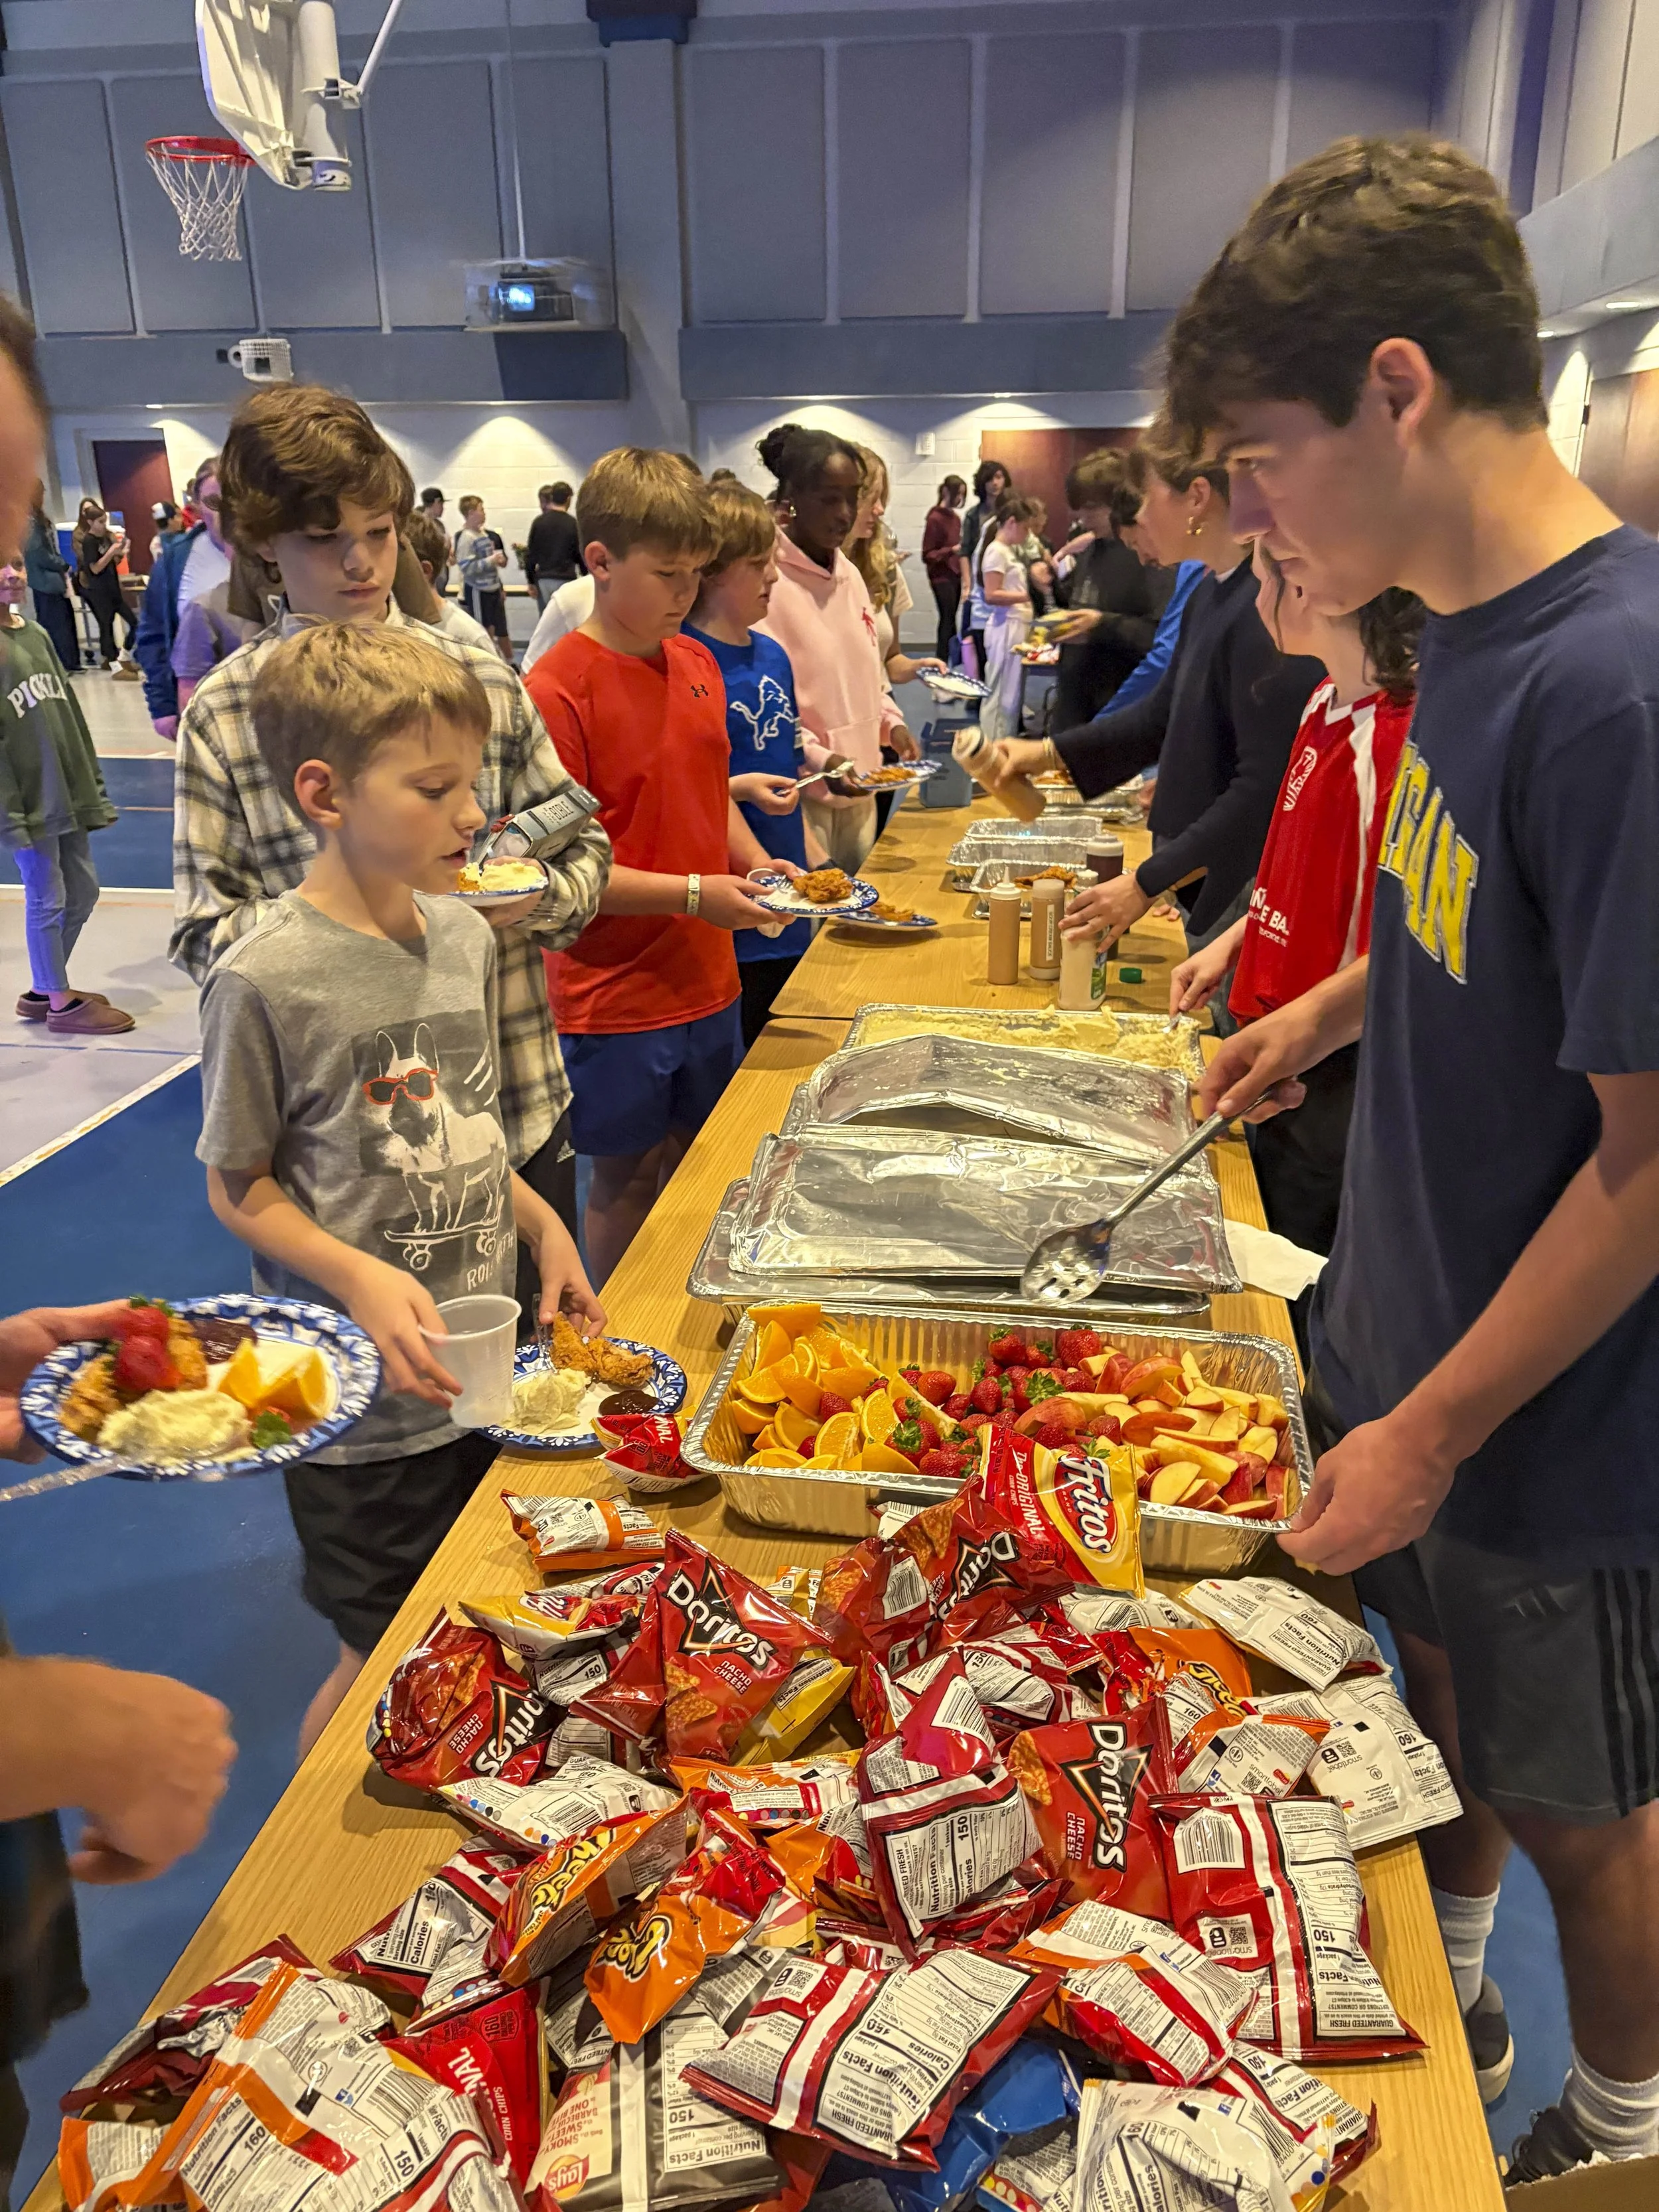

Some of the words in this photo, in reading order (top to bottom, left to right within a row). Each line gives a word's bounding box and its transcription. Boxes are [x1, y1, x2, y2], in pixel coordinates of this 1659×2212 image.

[1378, 737, 1480, 985] IGAN
[1015, 1473, 1046, 1534] ORIGINAL
[1059, 1453, 1114, 1554] Fritos
[936, 1531, 1017, 1621] Doritos
[670, 1574, 775, 1667] Doritos
[1283, 1621, 1306, 1641] Facts
[1271, 1633, 1291, 1650] FRESH
[1305, 1638, 1342, 1667] Nutrition
[584, 1663, 603, 1679] 150
[972, 1653, 989, 1668] 150
[1289, 1644, 1332, 1672] GUARANTEED
[713, 1666, 748, 1694] CHEESE
[721, 1660, 753, 1688] NACHO
[794, 1665, 833, 1688] Nutrition
[777, 1684, 798, 1704] Facts
[1184, 1706, 1202, 1720] 160
[448, 1712, 480, 1750] CHEESE
[455, 1720, 484, 1755] NACHO
[475, 1688, 544, 1777] oritos
[1398, 1732, 1417, 1746] 160
[1327, 1755, 1364, 1773] smartlabel
[1248, 1763, 1285, 1795] smartlabel
[1092, 1724, 1128, 1868] Doritos
[1423, 1787, 1442, 1799] FRESH
[958, 1815, 969, 1842] 150
[1065, 1811, 1076, 1860] CHEESE
[1074, 1812, 1086, 1861] NACHO
[929, 1854, 940, 1913] Nutrition
[409, 1920, 430, 1965] Calories
[1313, 1929, 1336, 1943] 150
[1319, 1971, 1349, 1982] Facts
[485, 2014, 499, 2037] 160
[1329, 2019, 1351, 2028] FRESH
[1352, 2019, 1394, 2028] GUARANTEED
[842, 2050, 875, 2074] Facts
[908, 2041, 950, 2071] Calories
[1299, 2077, 1323, 2095] ition
[493, 2086, 509, 2114] CHIPS
[569, 2099, 590, 2114] ONE
[836, 2089, 870, 2111] COMMENTS?
[431, 2110, 451, 2142] Facts
[669, 2108, 695, 2124] 150
[831, 2108, 855, 2128] FRESH
[181, 2125, 218, 2177] Nutrition
[215, 2096, 243, 2126] Facts
[244, 2125, 267, 2152] 160
[502, 2118, 513, 2142] CORN
[855, 2120, 894, 2144] RANTEED
[669, 2150, 703, 2165] Facts
[706, 2140, 760, 2158] Nutrition
[393, 2149, 415, 2177] 150
[547, 2161, 584, 2193] Lay's
[1144, 2164, 1165, 2212] alories
